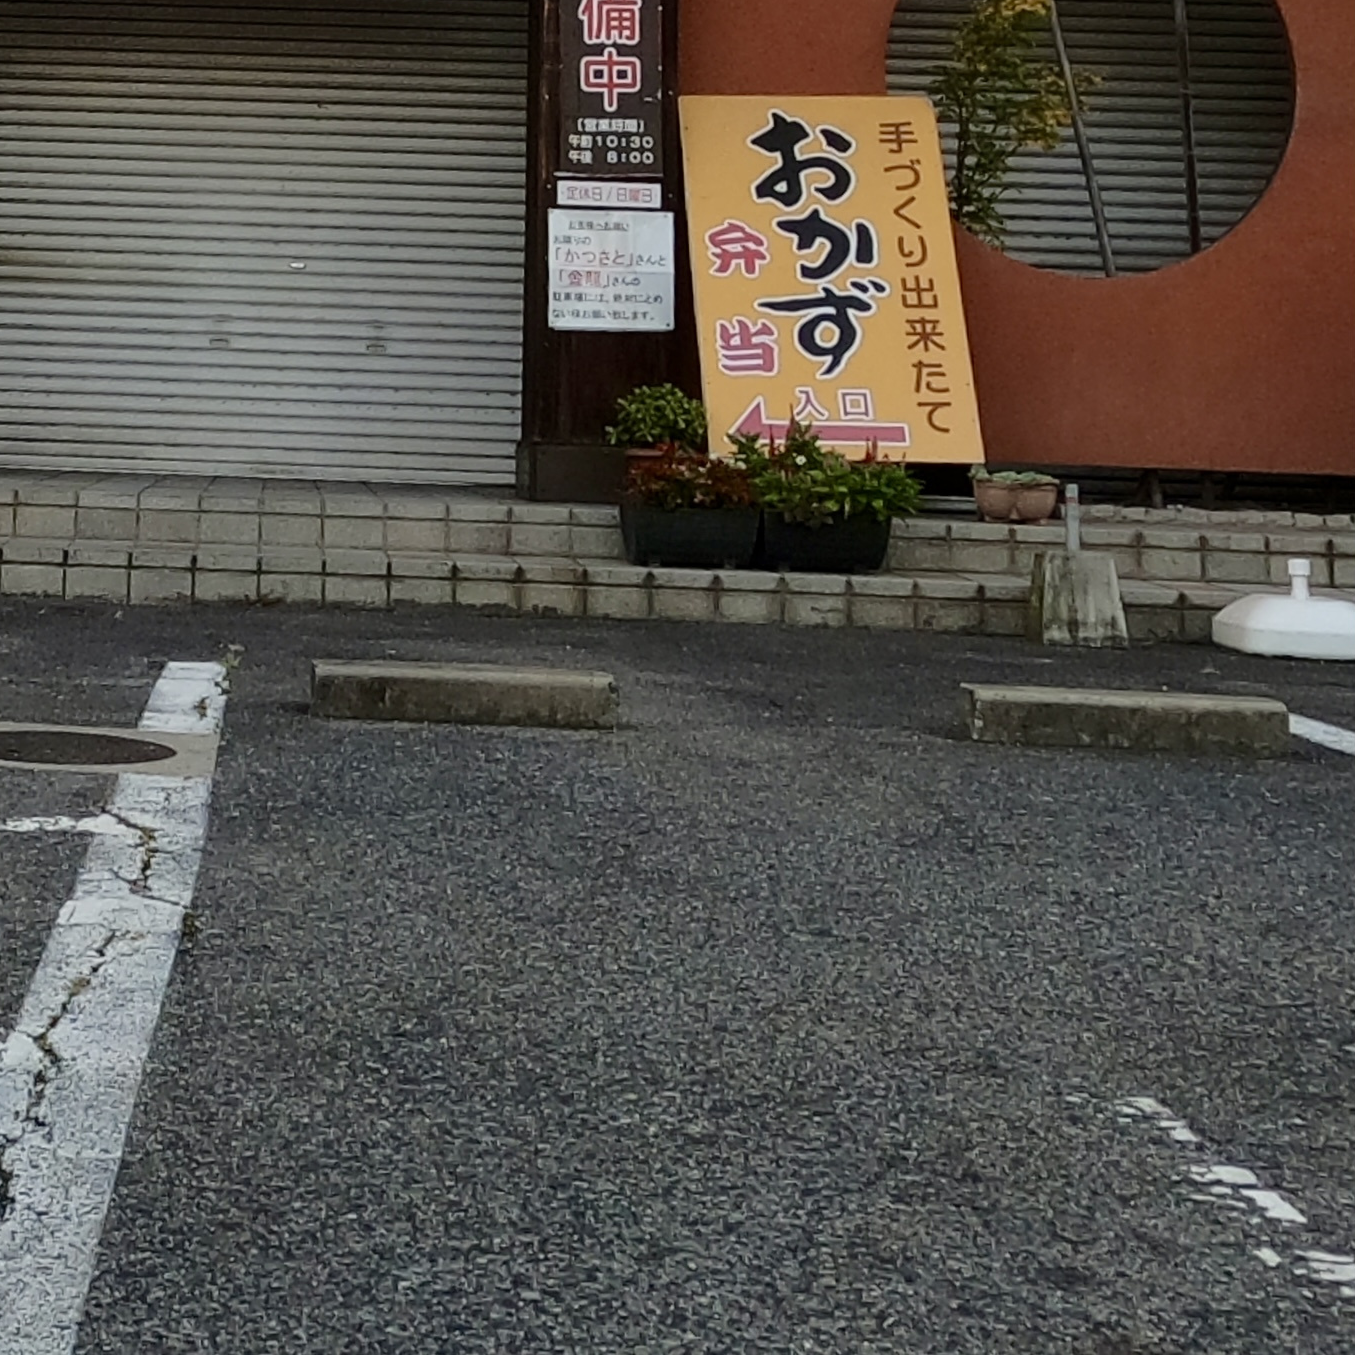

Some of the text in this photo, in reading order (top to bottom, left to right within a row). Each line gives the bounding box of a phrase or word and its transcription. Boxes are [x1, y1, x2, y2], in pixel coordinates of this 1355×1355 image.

[706, 220, 779, 376] 弁当
[749, 109, 892, 379] おかず
[878, 120, 953, 434] 手づくり出来たて
[793, 387, 875, 422] 入口
